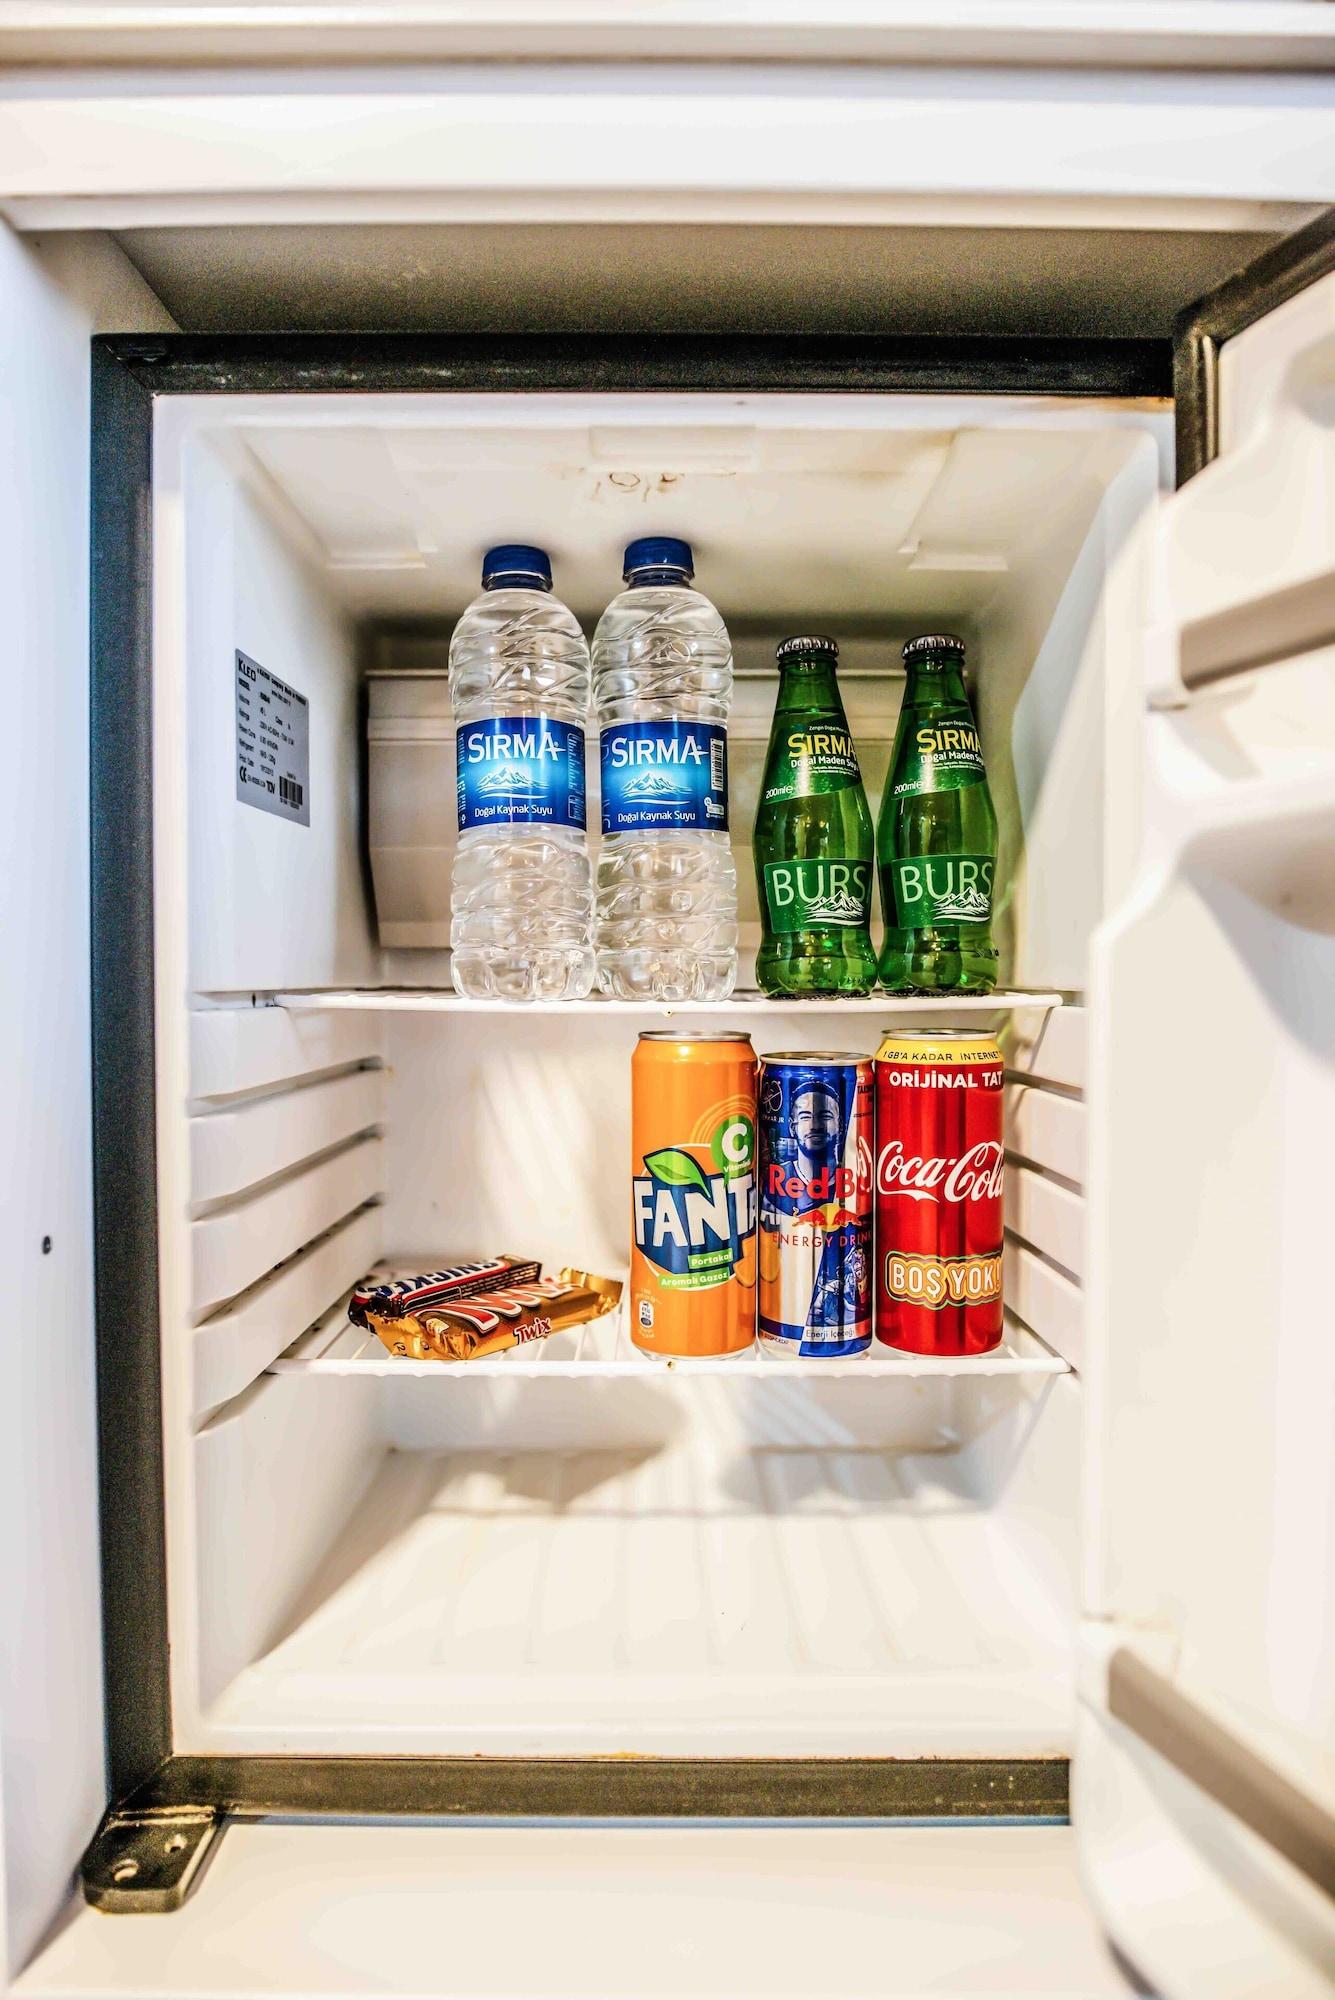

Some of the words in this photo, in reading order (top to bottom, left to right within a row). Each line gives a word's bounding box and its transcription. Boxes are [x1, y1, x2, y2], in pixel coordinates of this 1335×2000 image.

[468, 732, 563, 763] SIRMA
[611, 735, 706, 768] SIRMA
[818, 756, 846, 766] Maden
[949, 751, 975, 761] Maden
[474, 805, 496, 818] Doğal
[497, 803, 530, 817] Kaynak
[531, 804, 553, 816] Suyu
[618, 811, 639, 823] Doğal
[640, 810, 673, 822] Kaynak
[674, 810, 696, 822] Suyu
[911, 1052, 953, 1062] KADAR
[769, 1163, 830, 1199] Red
[772, 1231, 833, 1248] ENERGY
[691, 1251, 734, 1267] Portakal
[699, 1271, 728, 1283] Gazoz
[514, 1316, 552, 1346] Twix
